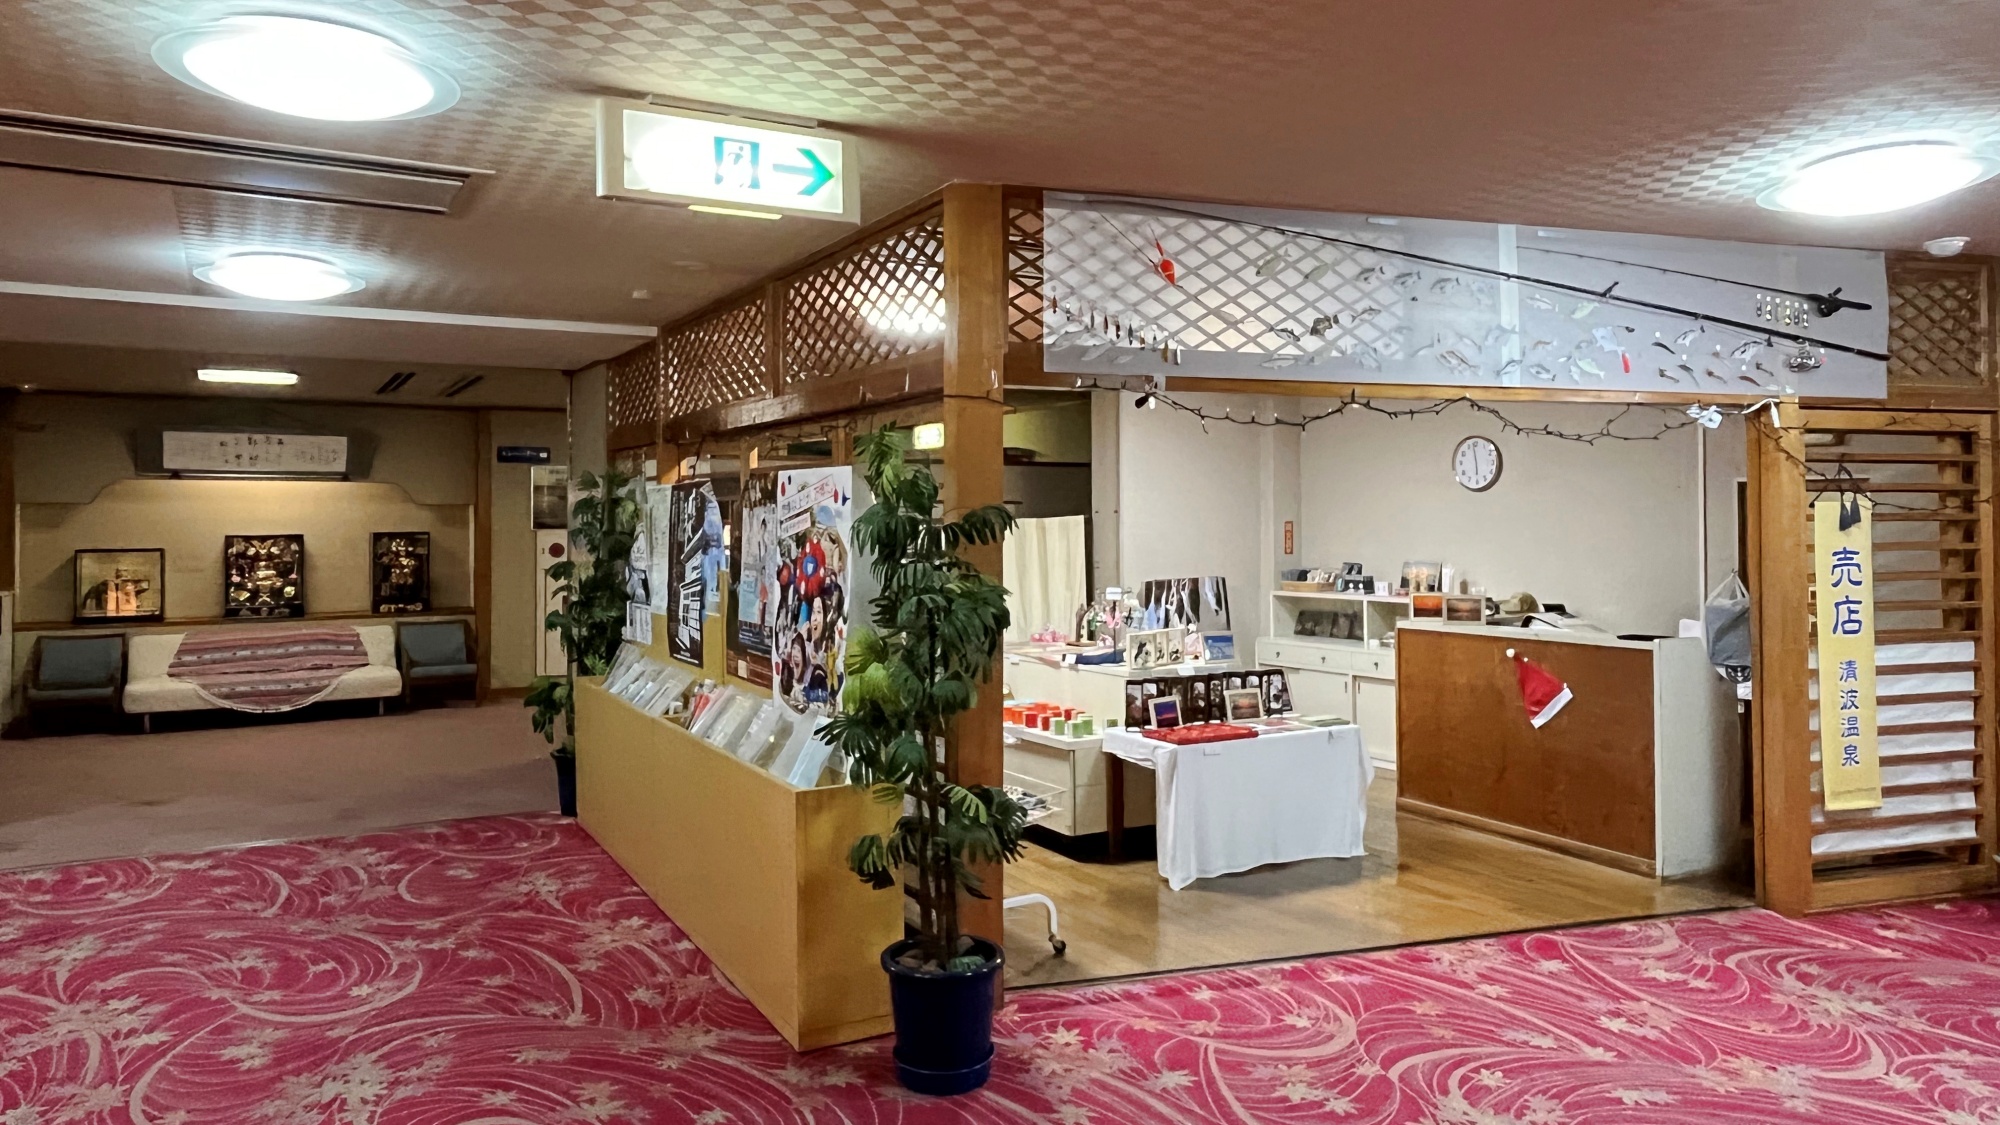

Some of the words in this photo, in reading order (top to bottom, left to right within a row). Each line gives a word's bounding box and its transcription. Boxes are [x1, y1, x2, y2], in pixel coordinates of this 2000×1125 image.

[1831, 546, 1863, 635] 売店
[1839, 659, 1860, 767] 清波温泉
